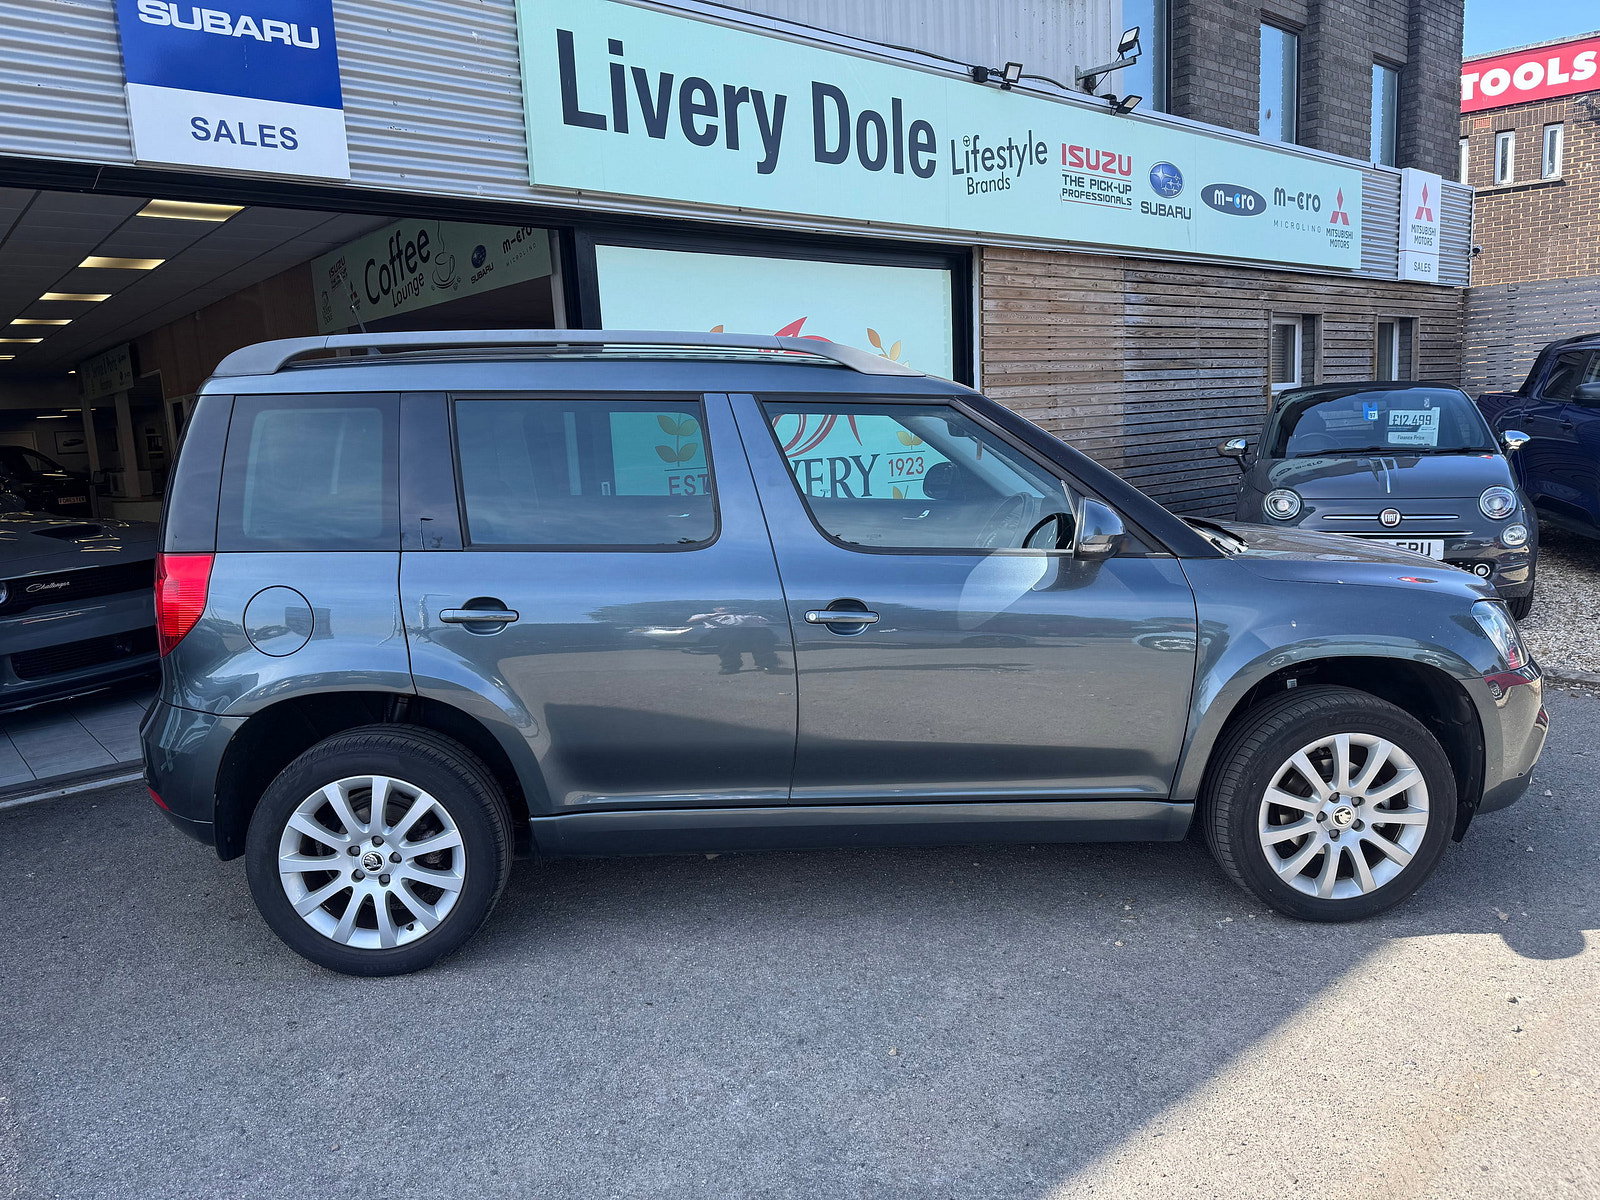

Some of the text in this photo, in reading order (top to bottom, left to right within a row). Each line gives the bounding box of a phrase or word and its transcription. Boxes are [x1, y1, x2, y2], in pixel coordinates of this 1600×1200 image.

[137, 0, 320, 50] SUBARU
[1460, 50, 1598, 101] TOOLS
[555, 28, 937, 179] Livery Dole
[190, 116, 299, 151] SALES
[950, 129, 1048, 178] Lifestyle
[1061, 143, 1132, 176] ISUZU
[966, 171, 1011, 195] Brands
[1061, 174, 1132, 195] THE PICK-UP
[1061, 188, 1132, 206] PROFESSIONALS
[1140, 200, 1192, 220] SUBARU
[1273, 219, 1322, 234] MICROLINO
[1325, 227, 1354, 240] MITSUBISHI
[1410, 223, 1437, 237] MITSUBISHI
[1329, 238, 1351, 249] MOTORS
[1413, 235, 1433, 247] MOTORS
[365, 229, 431, 305] Coffee
[470, 262, 495, 284] SUBARU
[1413, 261, 1432, 273] SALES
[391, 272, 425, 308] Lounge
[888, 456, 925, 477] 1923
[26, 581, 71, 593] Challenger
